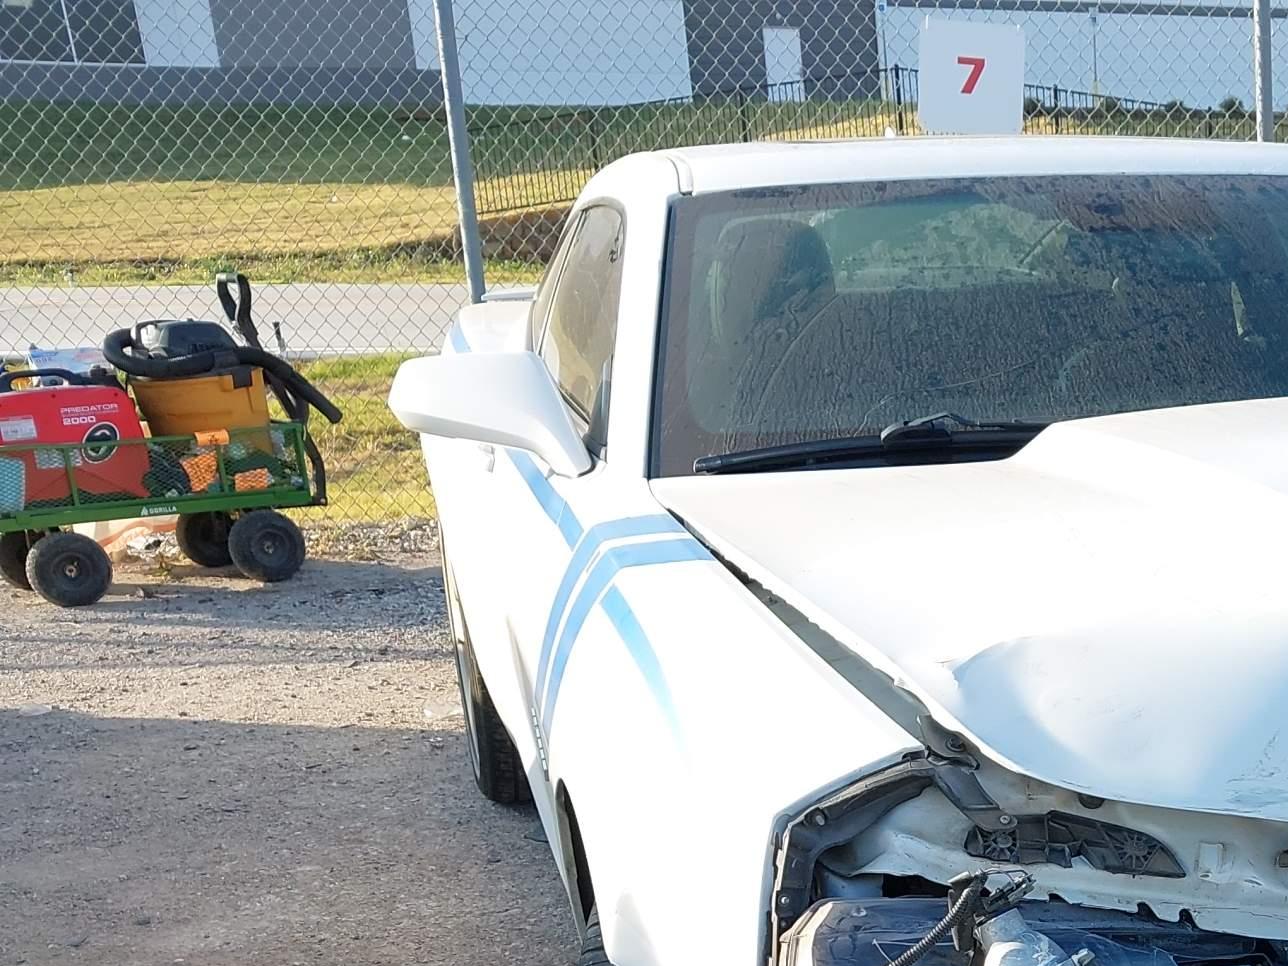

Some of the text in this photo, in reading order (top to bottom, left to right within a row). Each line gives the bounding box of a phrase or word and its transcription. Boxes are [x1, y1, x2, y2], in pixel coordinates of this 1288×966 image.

[957, 56, 986, 94] 7
[60, 403, 118, 413] PREDATOR
[63, 415, 96, 425] 2000
